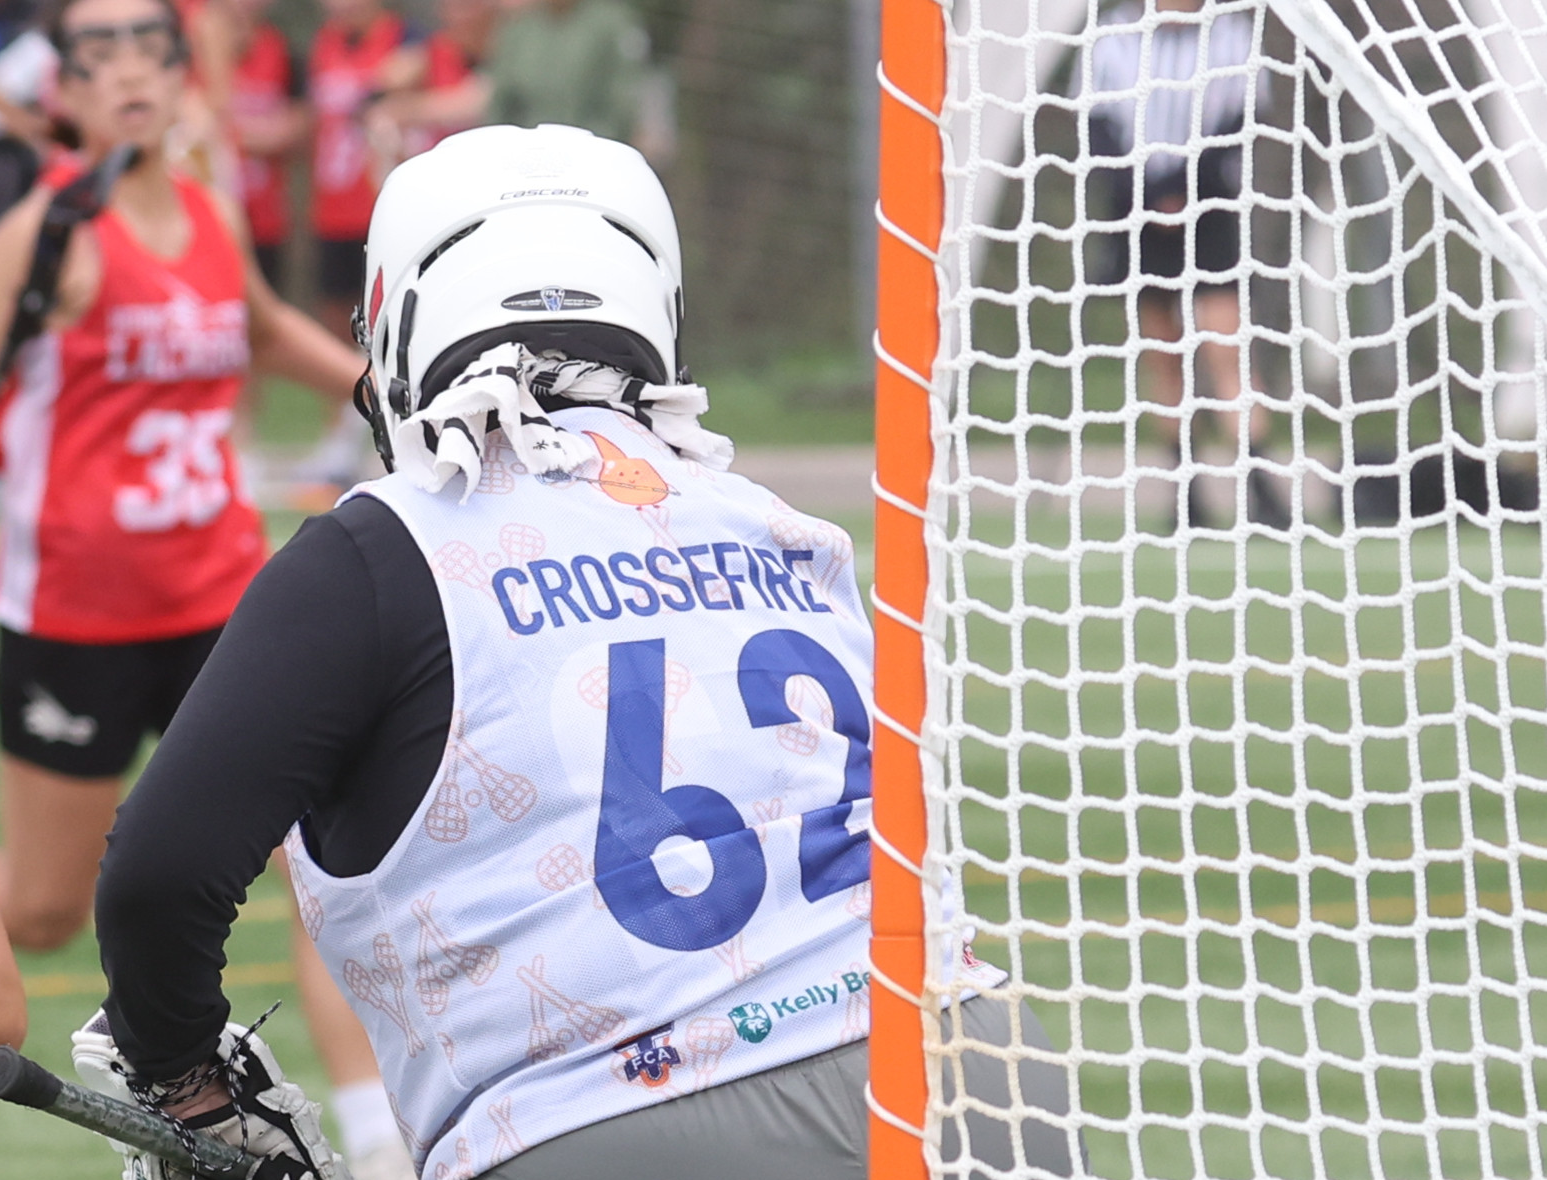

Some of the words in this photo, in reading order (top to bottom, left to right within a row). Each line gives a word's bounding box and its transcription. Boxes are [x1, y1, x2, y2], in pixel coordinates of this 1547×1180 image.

[499, 188, 589, 200] cascade
[492, 542, 831, 635] CROSSEFIRE
[594, 628, 871, 951] 62
[771, 984, 838, 1018] Kelly
[632, 1048, 671, 1070] FCA
